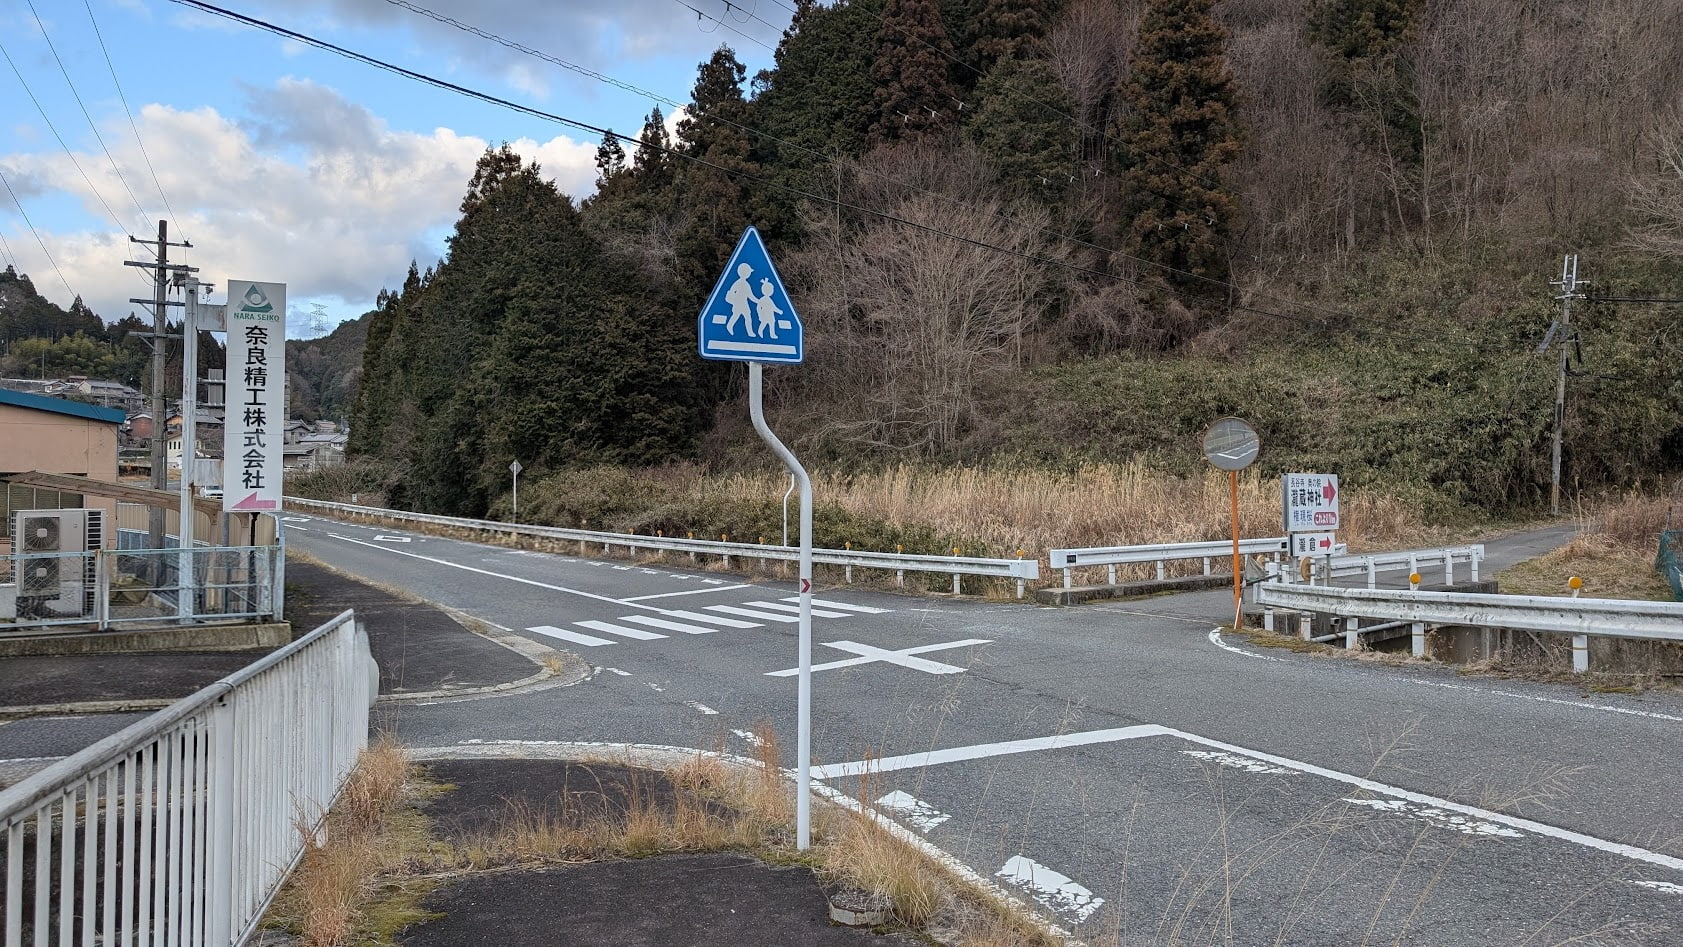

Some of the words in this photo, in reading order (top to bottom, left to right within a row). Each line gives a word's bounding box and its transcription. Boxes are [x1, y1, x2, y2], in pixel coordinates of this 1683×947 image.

[233, 312, 255, 320] NARA
[257, 313, 280, 321] SEIKO
[242, 325, 268, 489] 奈良精工株式会社
